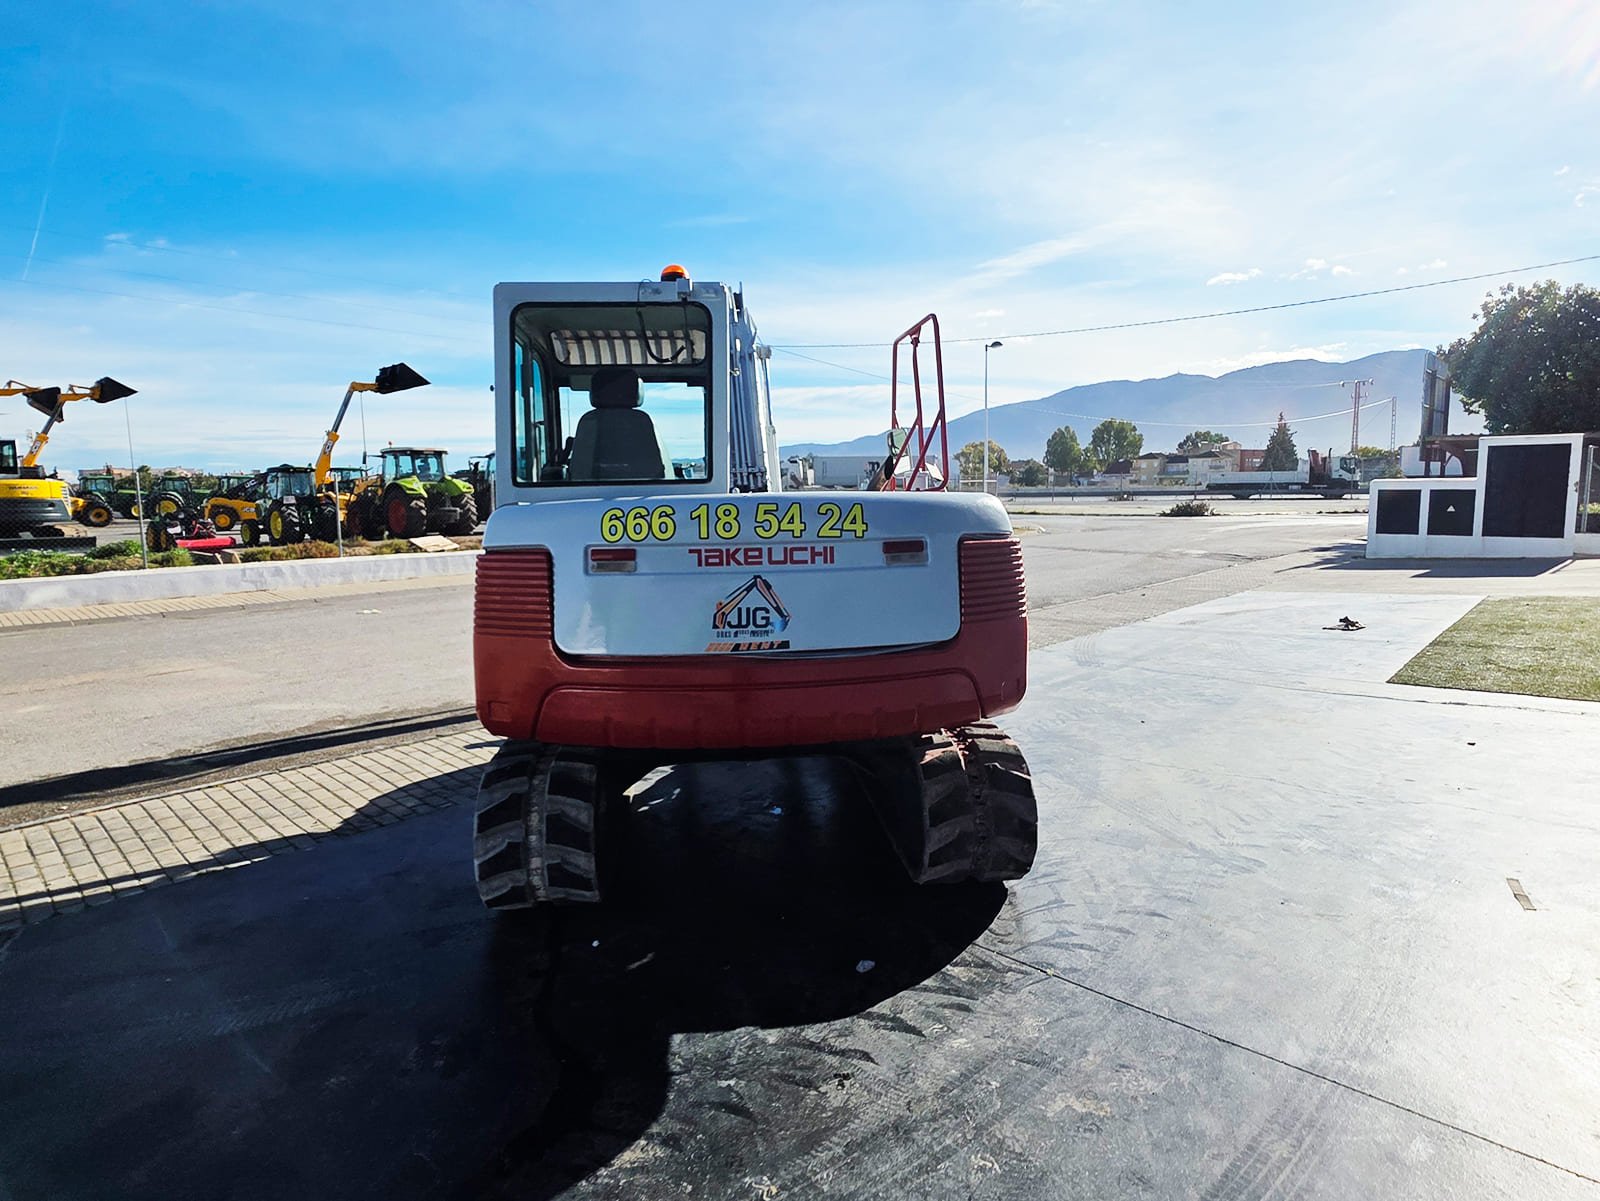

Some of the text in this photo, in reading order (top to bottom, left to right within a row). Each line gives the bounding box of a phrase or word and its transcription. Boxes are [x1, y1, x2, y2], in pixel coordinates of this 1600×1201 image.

[601, 503, 868, 543] 666 18 54 24
